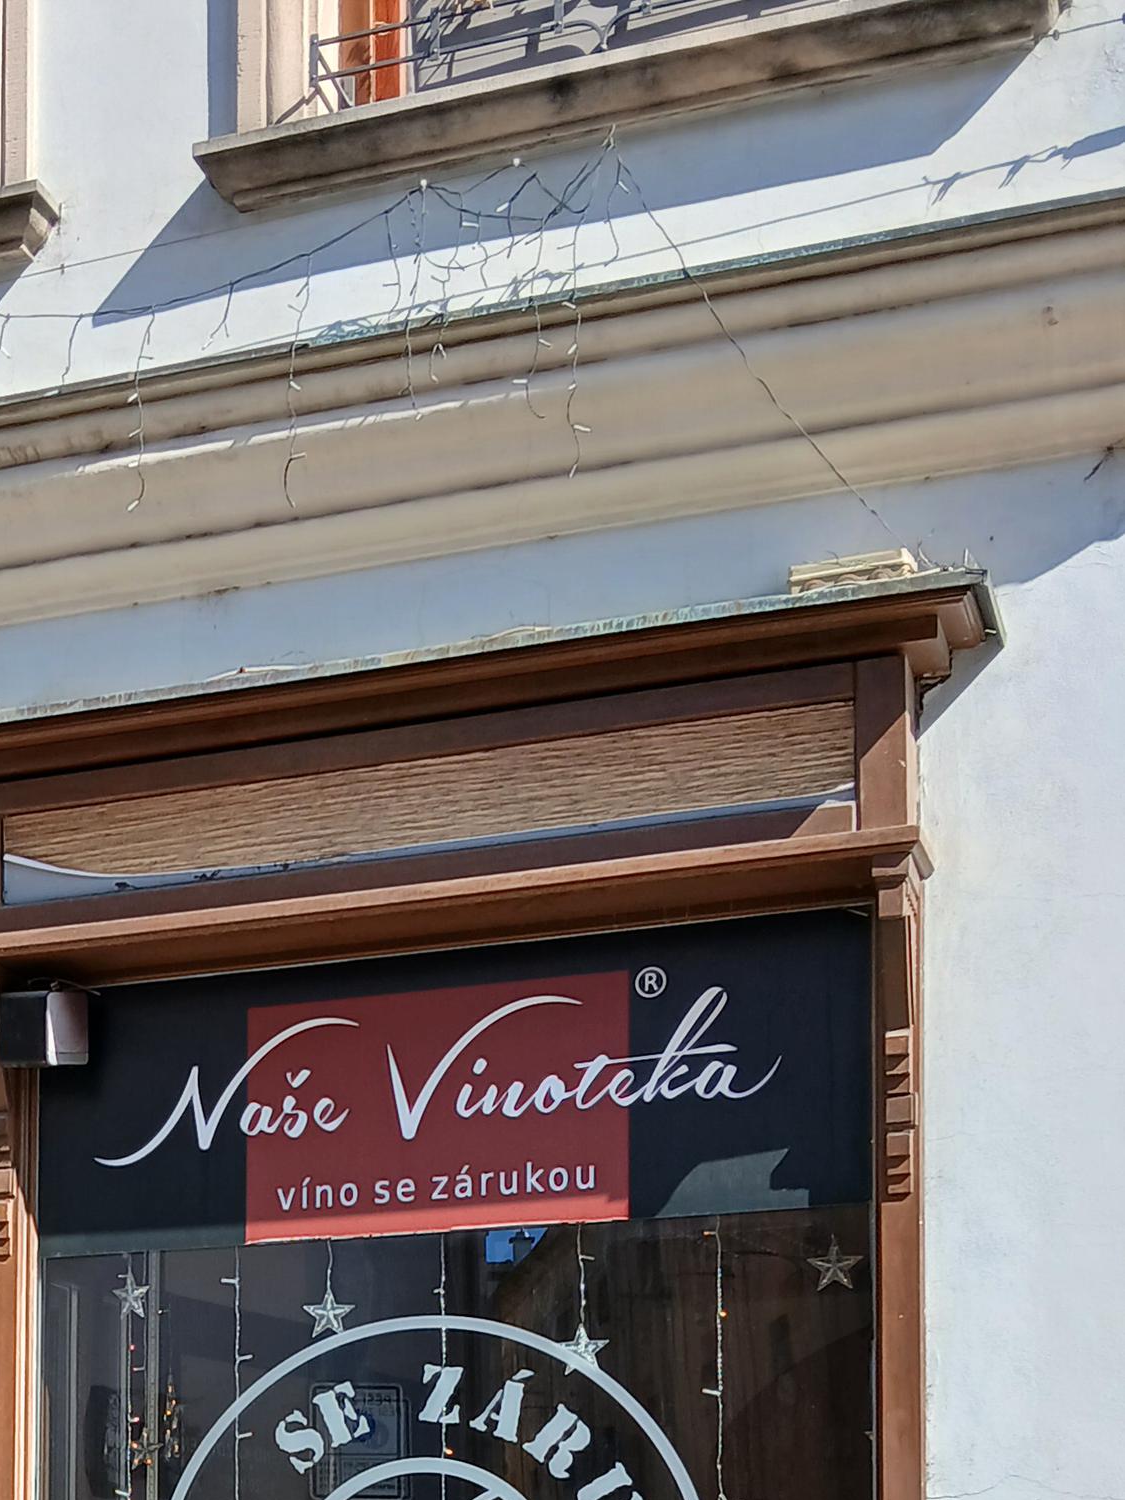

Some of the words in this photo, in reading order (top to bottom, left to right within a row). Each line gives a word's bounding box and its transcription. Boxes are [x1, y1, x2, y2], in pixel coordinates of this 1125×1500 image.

[94, 1016, 360, 1168] Naše
[386, 986, 782, 1141] Vinoteka
[277, 1172, 359, 1211] víno
[373, 1175, 416, 1204] se
[431, 1161, 597, 1200] zárukou
[275, 1381, 370, 1475] SE
